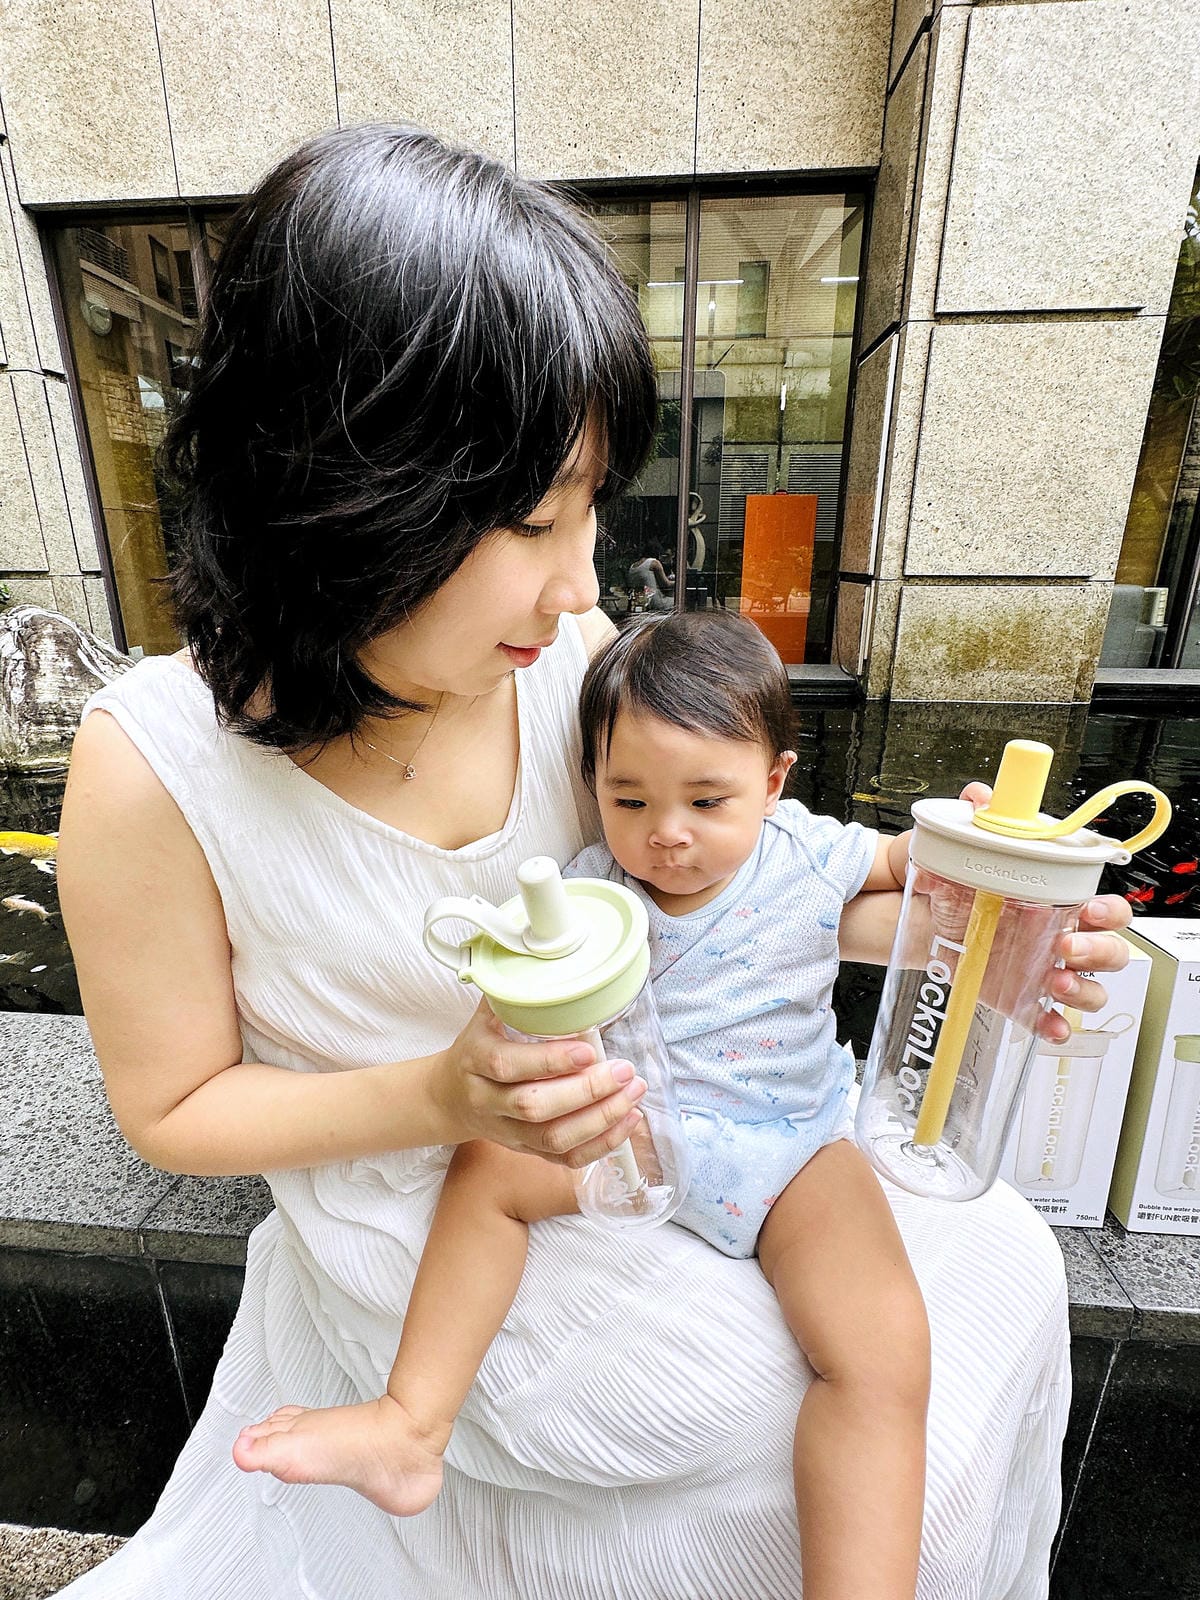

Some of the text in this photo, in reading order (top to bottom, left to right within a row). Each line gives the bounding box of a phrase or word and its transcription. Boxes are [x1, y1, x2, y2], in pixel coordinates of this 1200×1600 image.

[964, 857, 1048, 886] LocknLock
[1042, 1074, 1072, 1164] LocknLock
[1138, 1203, 1161, 1211] Bubble
[1076, 1214, 1100, 1222] 750mL
